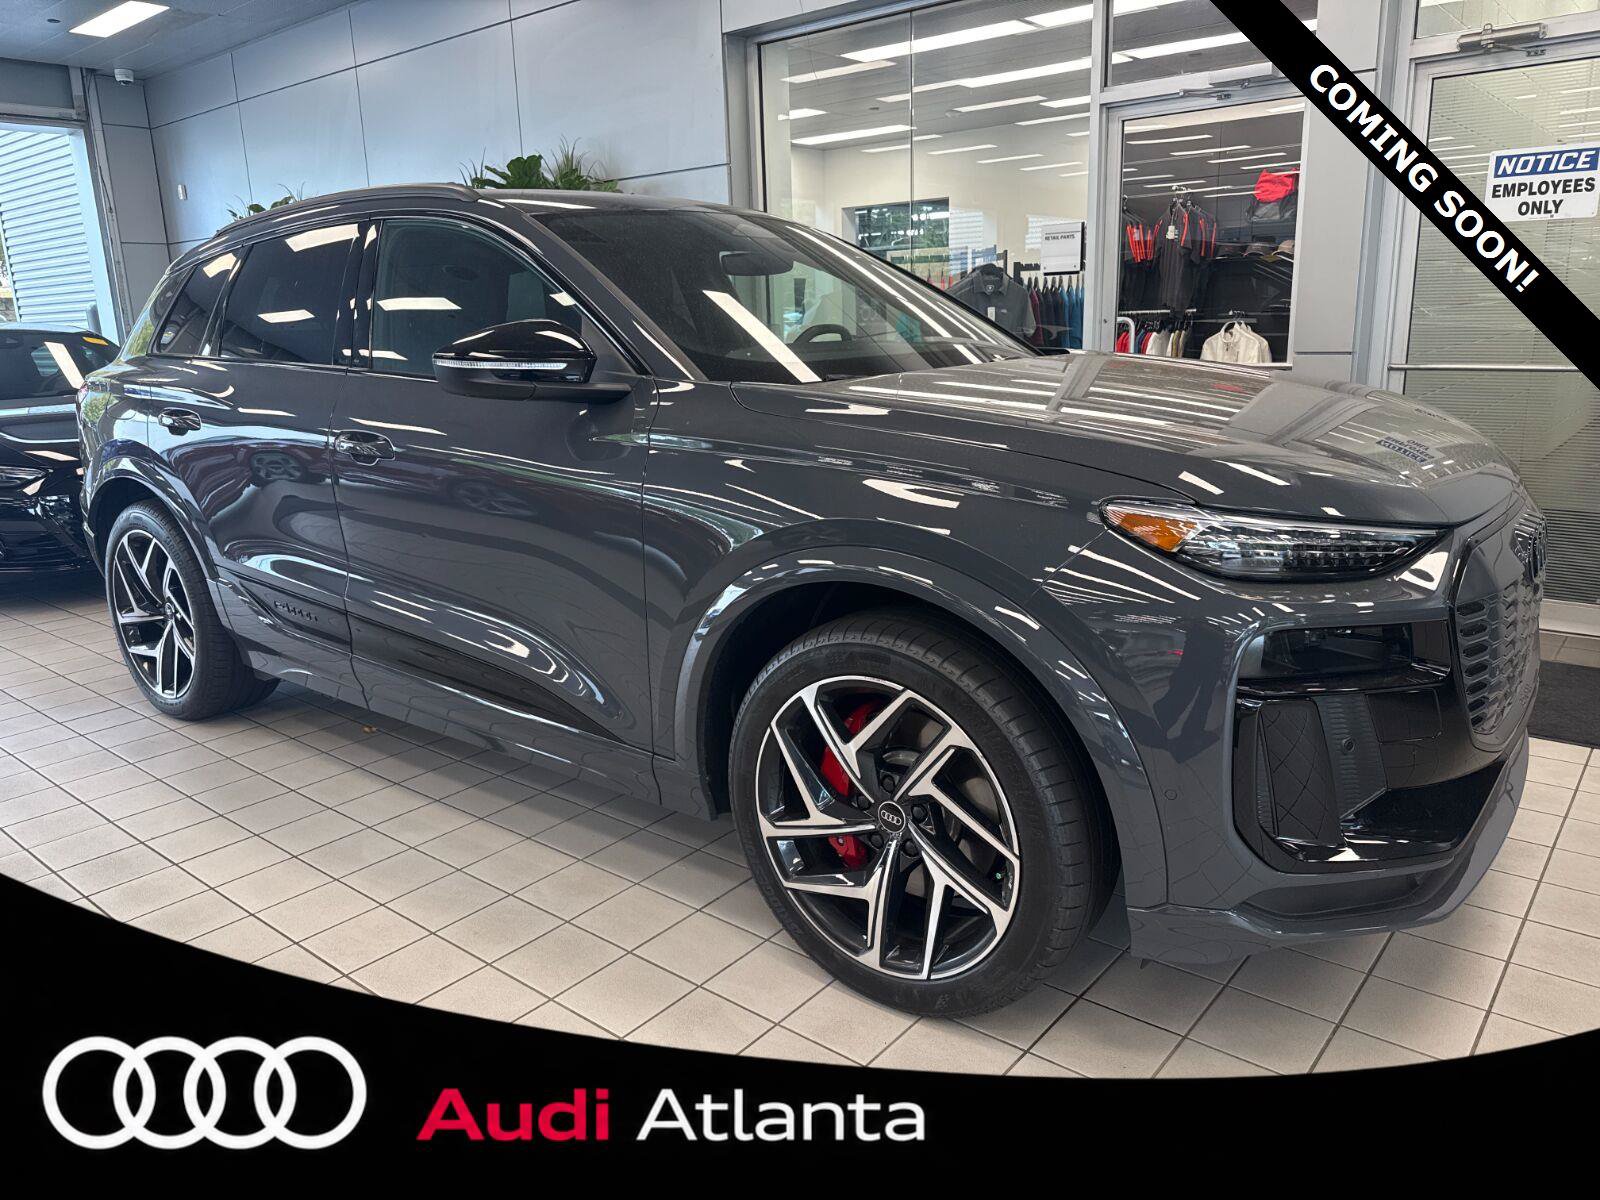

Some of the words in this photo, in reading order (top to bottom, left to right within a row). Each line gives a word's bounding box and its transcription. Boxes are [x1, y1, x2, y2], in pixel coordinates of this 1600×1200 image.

[1497, 150, 1597, 176] NOTICE
[1491, 177, 1596, 199] EMPLOYEES
[1517, 199, 1564, 216] ONLY
